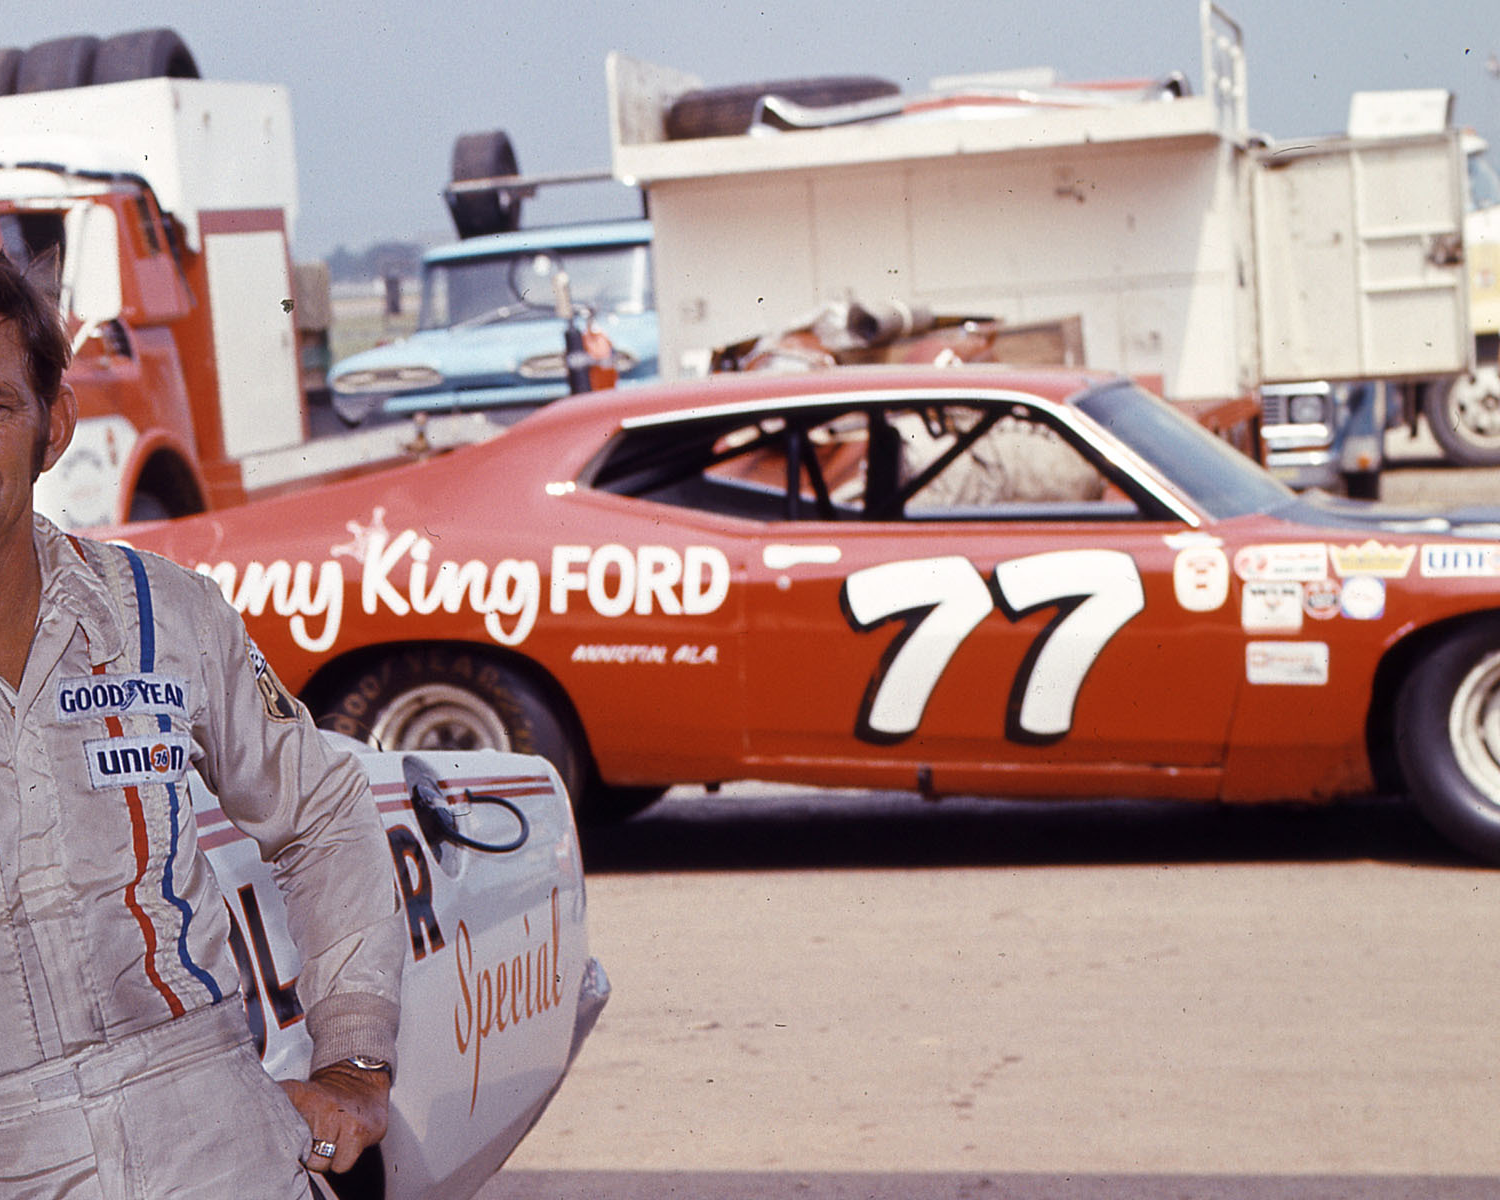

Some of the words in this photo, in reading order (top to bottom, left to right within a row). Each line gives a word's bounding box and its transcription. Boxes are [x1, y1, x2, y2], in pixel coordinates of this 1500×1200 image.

[362, 529, 540, 646] King
[550, 544, 731, 617] FORD
[839, 549, 1145, 746] 77
[155, 753, 169, 767] 76
[455, 887, 563, 1117] Special
